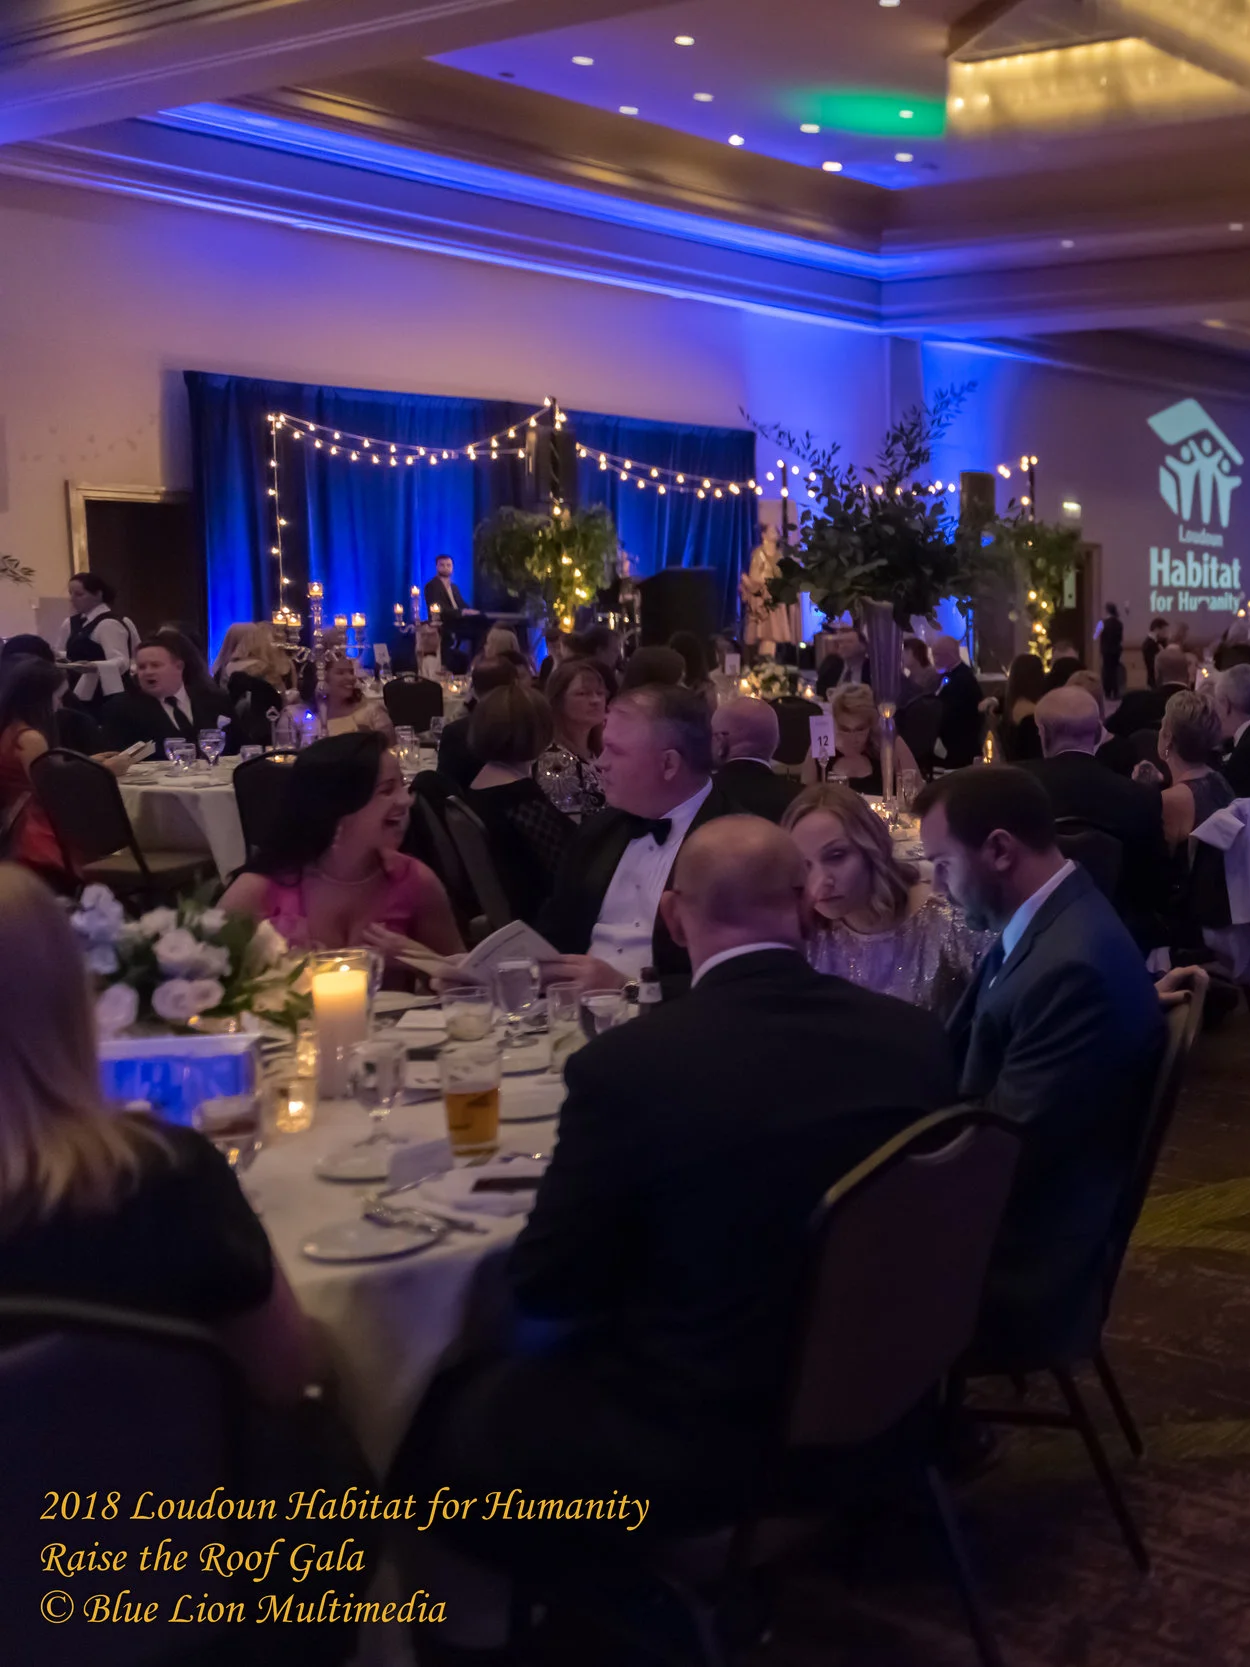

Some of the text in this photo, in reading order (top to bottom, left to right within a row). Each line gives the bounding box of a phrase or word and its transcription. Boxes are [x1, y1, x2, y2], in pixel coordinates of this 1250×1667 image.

[1149, 546, 1242, 589] Habitat
[1149, 588, 1174, 613] for
[817, 735, 829, 747] 12
